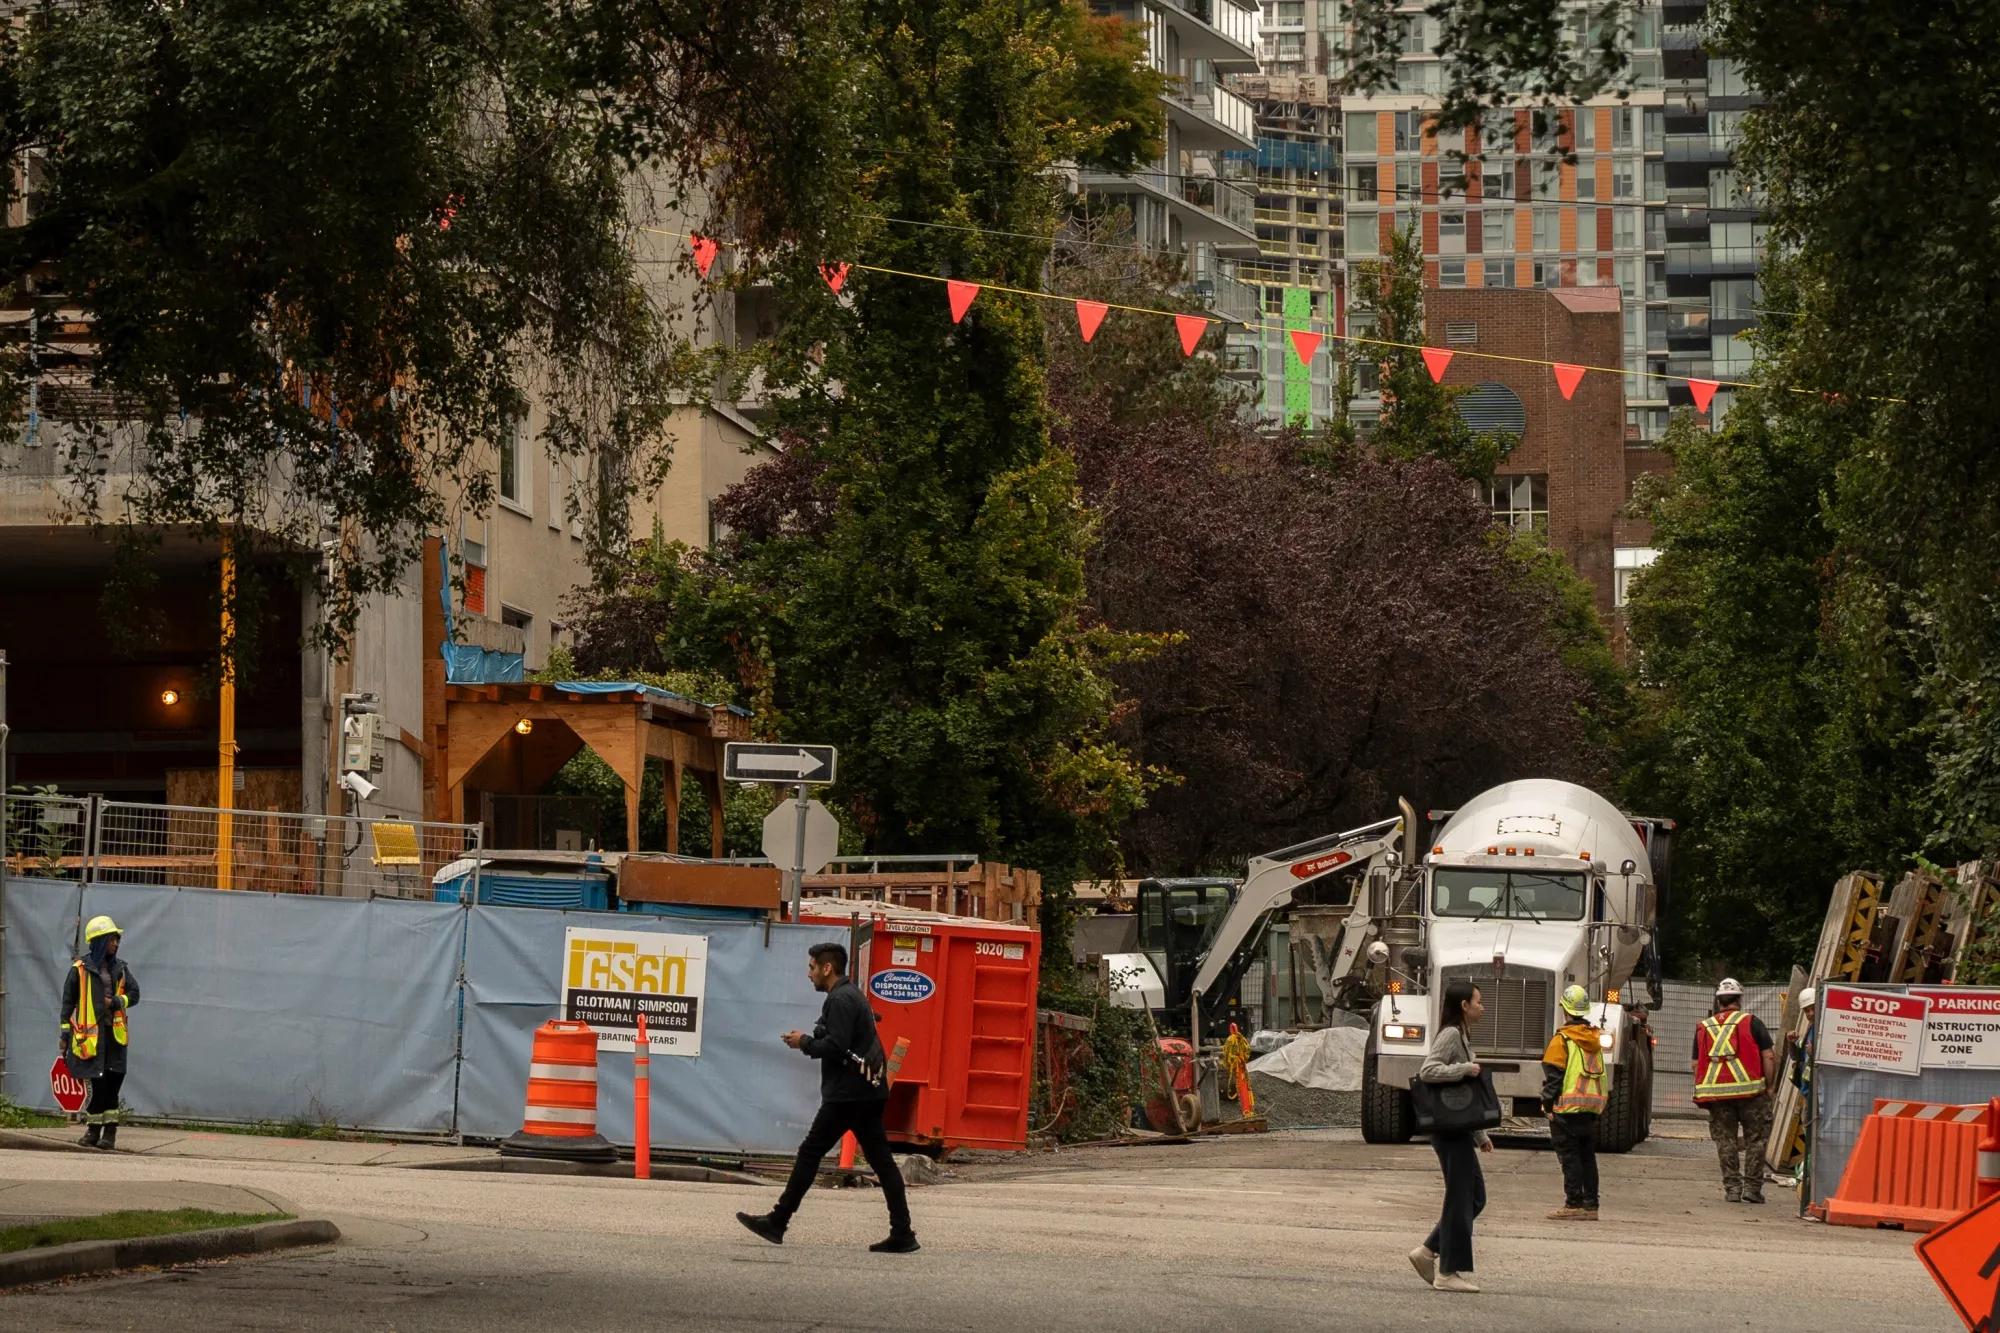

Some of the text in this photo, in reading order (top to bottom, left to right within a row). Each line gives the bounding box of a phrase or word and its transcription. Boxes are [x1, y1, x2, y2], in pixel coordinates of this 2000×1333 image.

[1316, 856, 1338, 869] Bobcat
[975, 942, 1003, 956] 3020
[884, 972, 920, 982] Cloverdale
[875, 982, 912, 990] DISPOSAL
[576, 995, 688, 1014] GLOTMAN SIMPSON
[1851, 996, 1900, 1014] STOP
[1939, 999, 2000, 1010] PARKING
[575, 1011, 633, 1022] STRUCTURAL
[1852, 1016, 1907, 1028] NON-ESSENTIAL
[1857, 1022, 1889, 1031] VISITORS
[1837, 1026, 1866, 1035] BEYOND
[649, 1035, 677, 1045] YEARS!
[1848, 1038, 1874, 1047] PLEASE
[1932, 1034, 1982, 1042] LOADING
[1854, 1045, 1903, 1056] MANAGEMENT
[1941, 1045, 1972, 1054] ZONE
[1852, 1052, 1902, 1062] APPOINTMENT
[54, 1074, 84, 1095] STOP
